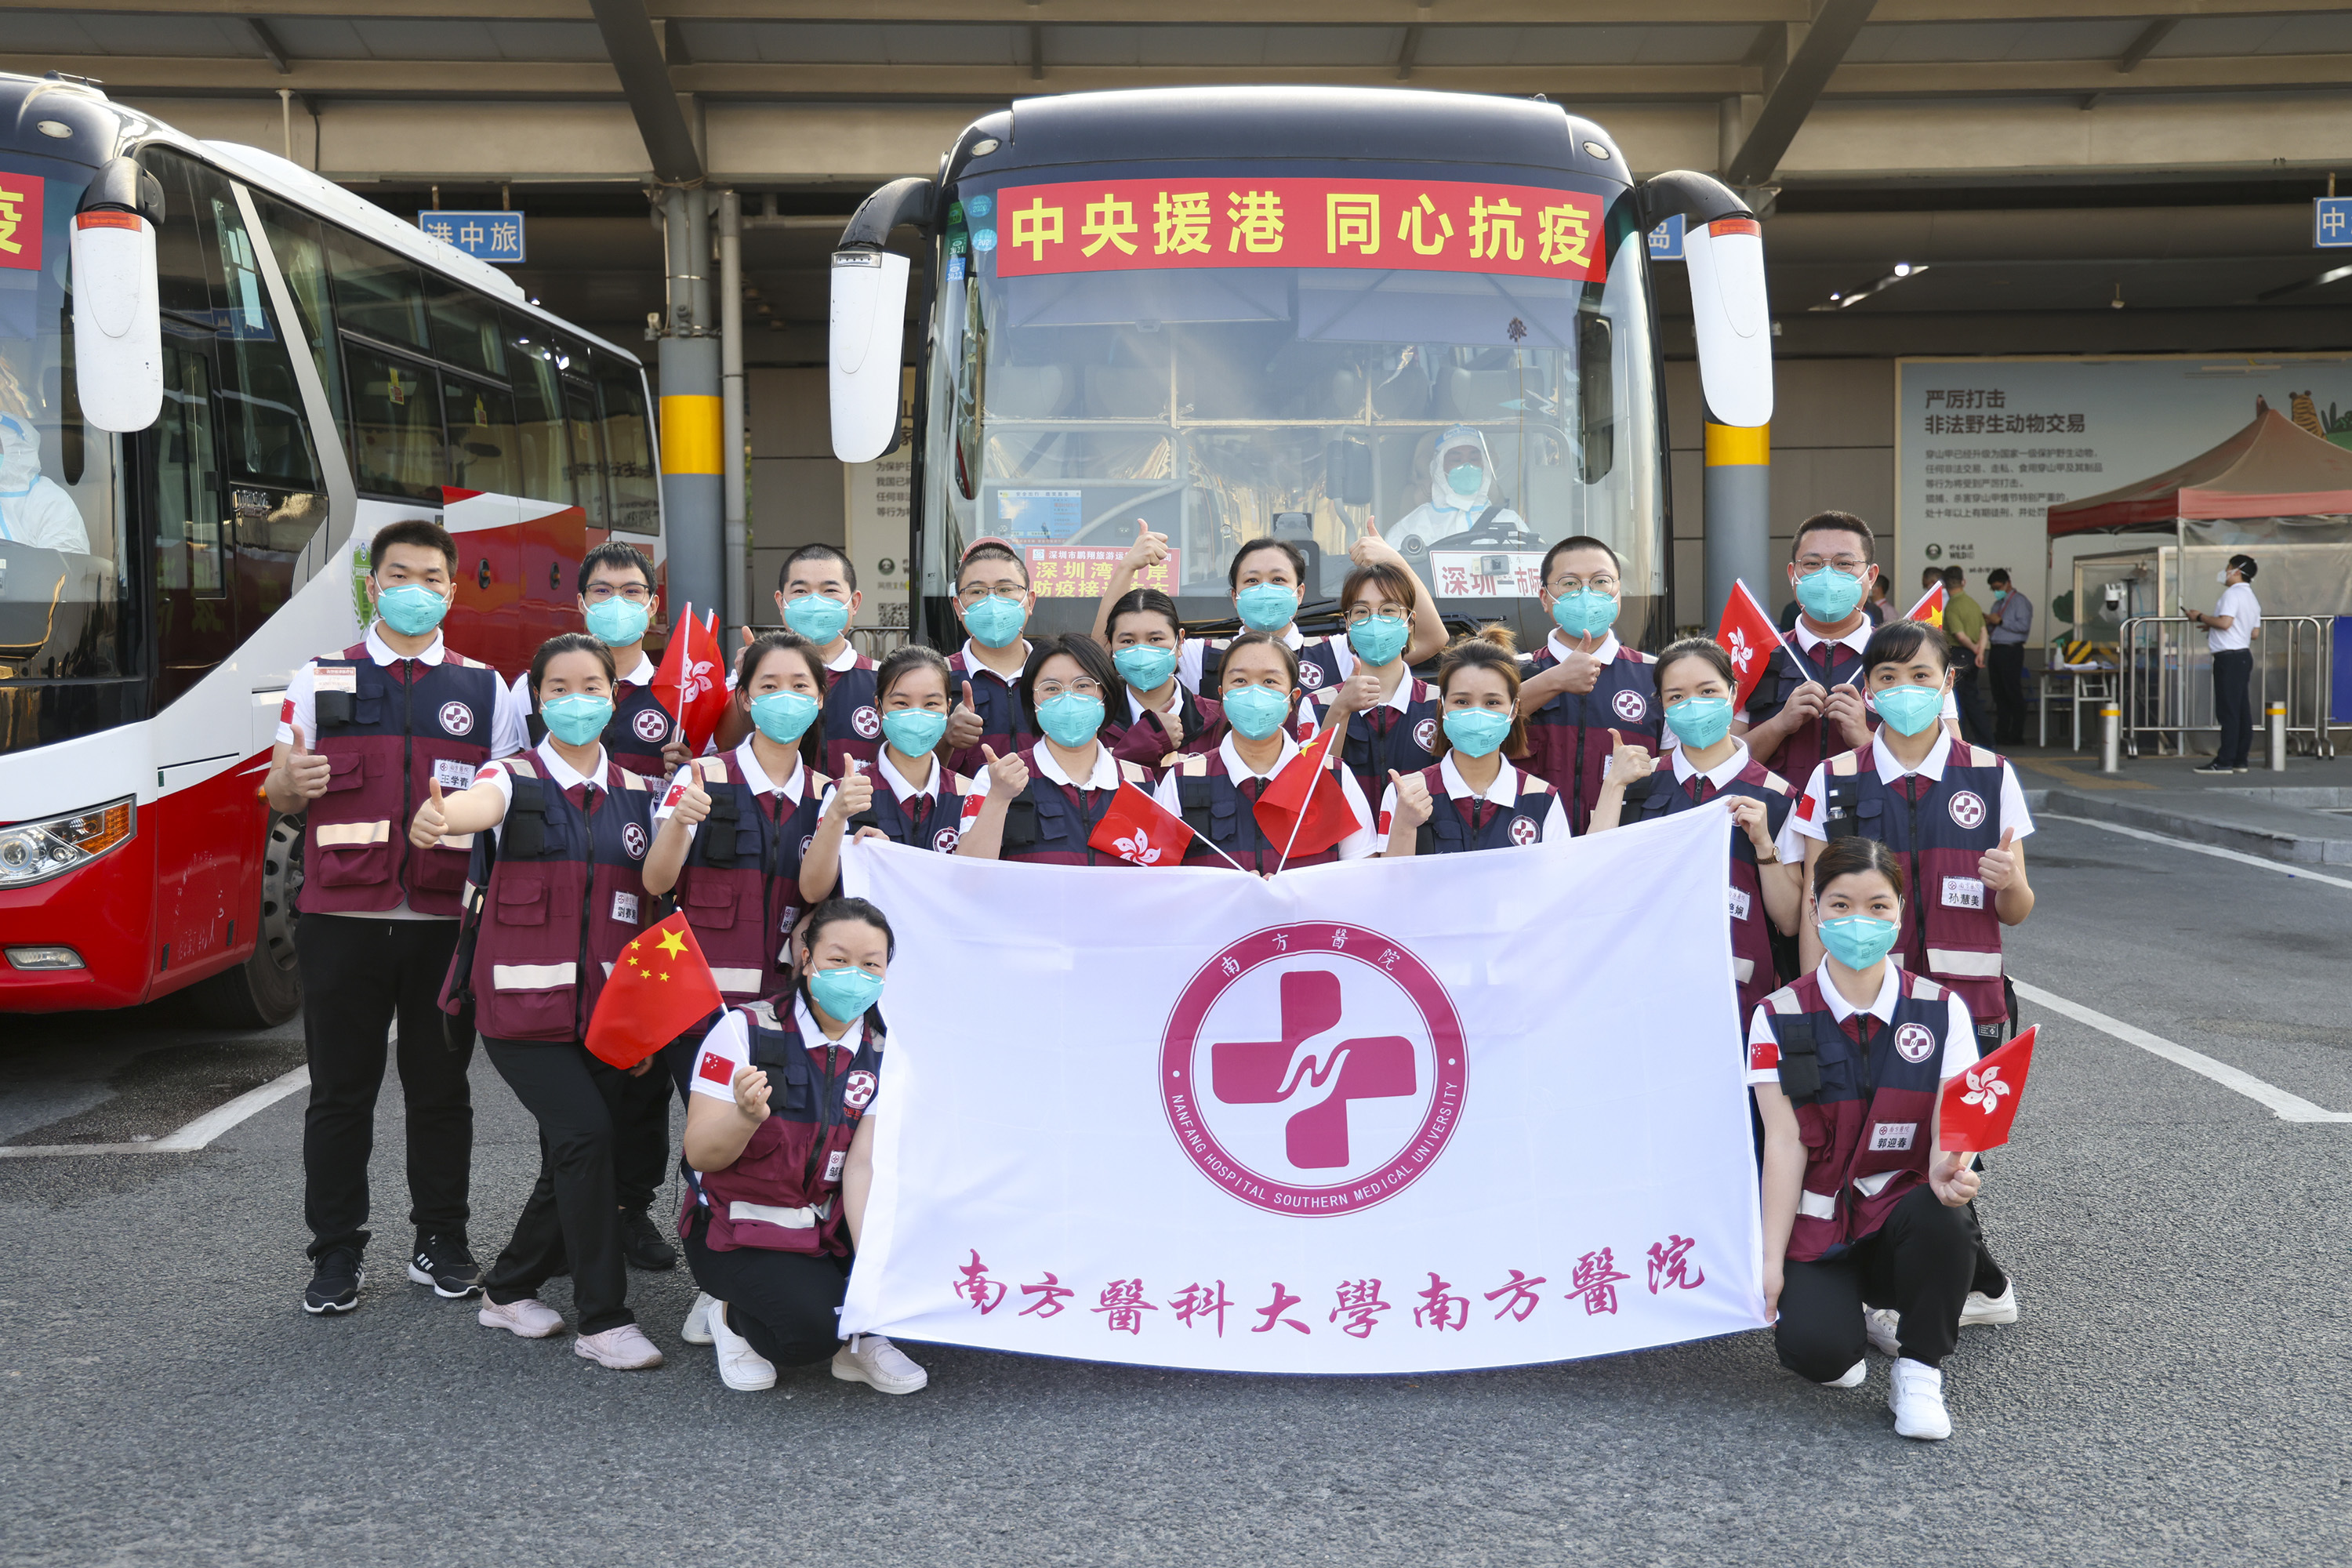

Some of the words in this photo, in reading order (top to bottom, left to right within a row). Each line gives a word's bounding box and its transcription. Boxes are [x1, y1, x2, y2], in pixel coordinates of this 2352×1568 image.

[426, 221, 517, 252] 港中旅
[1012, 191, 1284, 261] 中央援港
[1327, 194, 1592, 268] 同心抗疫
[949, 246, 964, 255] 2021
[947, 272, 963, 281] 2022
[1925, 389, 2005, 408] 严厉打击
[1925, 413, 2085, 434] 非法野生动物交易
[1036, 561, 1169, 581] 深圳湾岸
[1948, 893, 1980, 906] 孙慧美
[1221, 928, 1401, 978] 南方醫院
[1171, 1094, 1207, 1153] NANFANG
[1203, 1152, 1266, 1200] HOSPITAL
[1274, 1192, 1348, 1208] SOUTHERN
[1354, 1164, 1414, 1200] MEDICAL
[1411, 1082, 1458, 1163] UNIVERSITY
[1877, 1138, 1907, 1149] 郭迎春
[953, 1234, 1704, 1339] 南方醫科大學南方醫院
